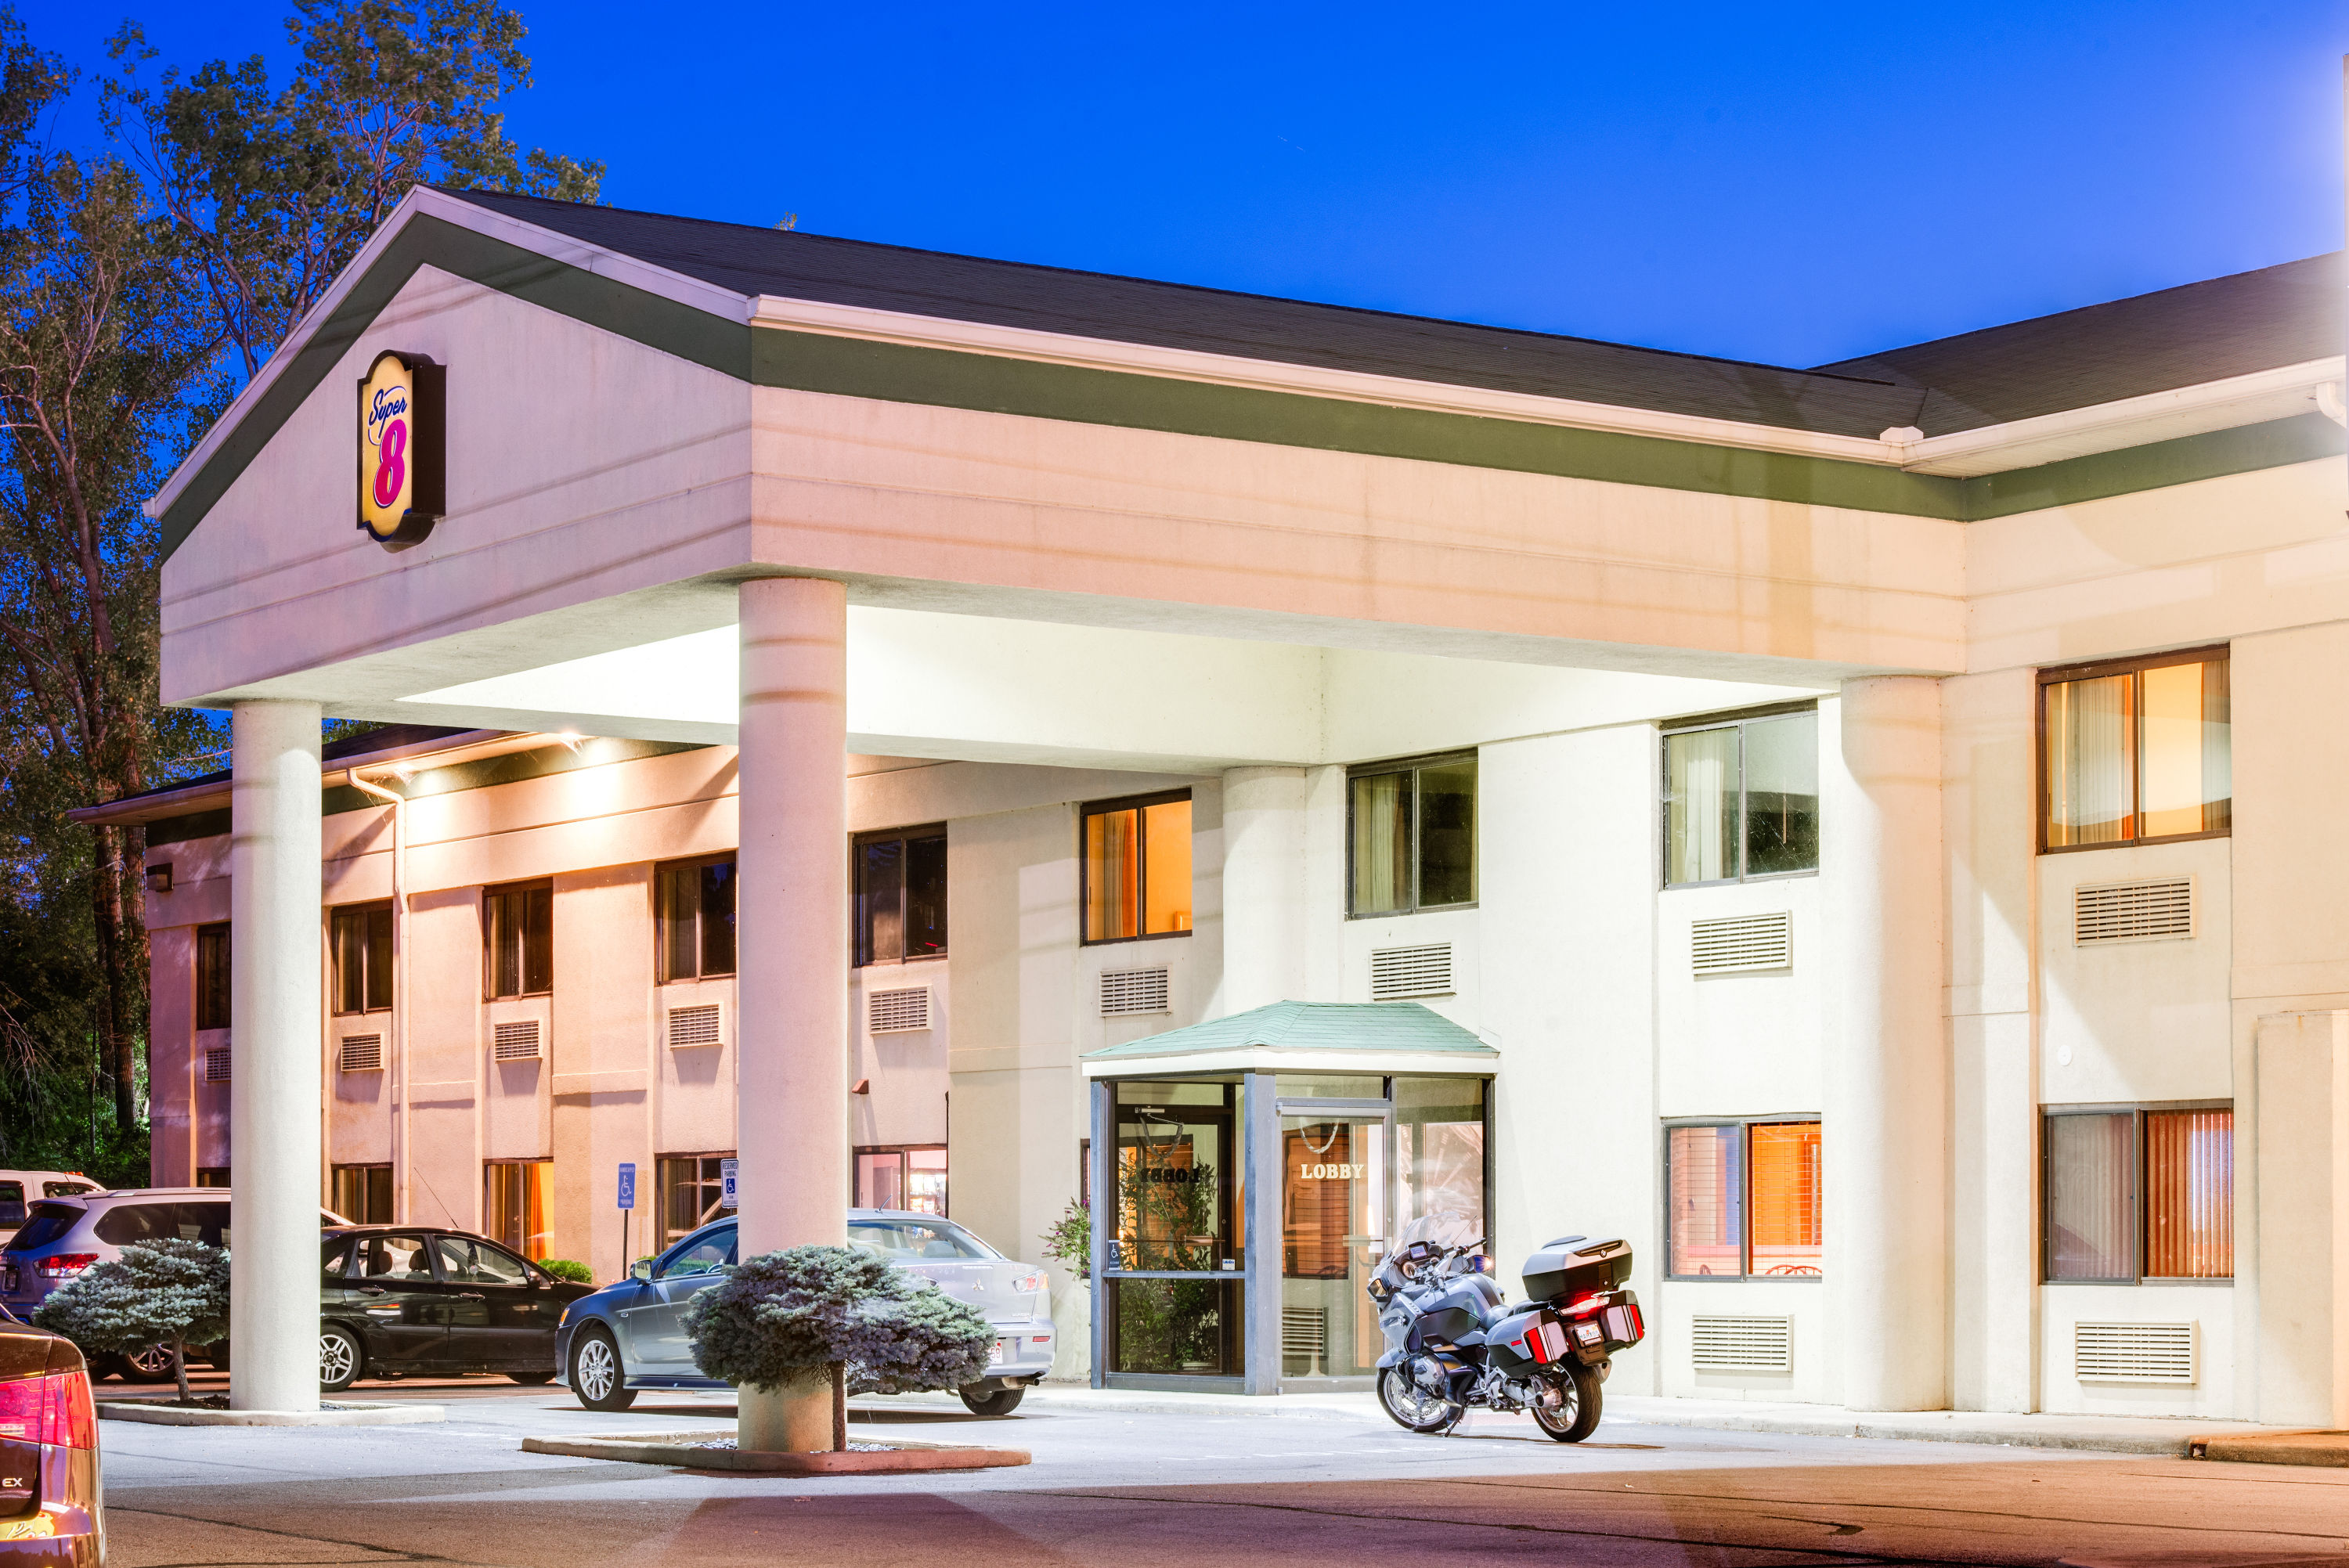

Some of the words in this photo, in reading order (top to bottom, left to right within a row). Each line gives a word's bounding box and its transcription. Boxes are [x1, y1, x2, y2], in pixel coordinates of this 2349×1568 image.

[368, 386, 407, 442] Super
[373, 419, 406, 509] 8
[1301, 1164, 1364, 1179] LOBBY
[2, 1477, 23, 1487] EX
